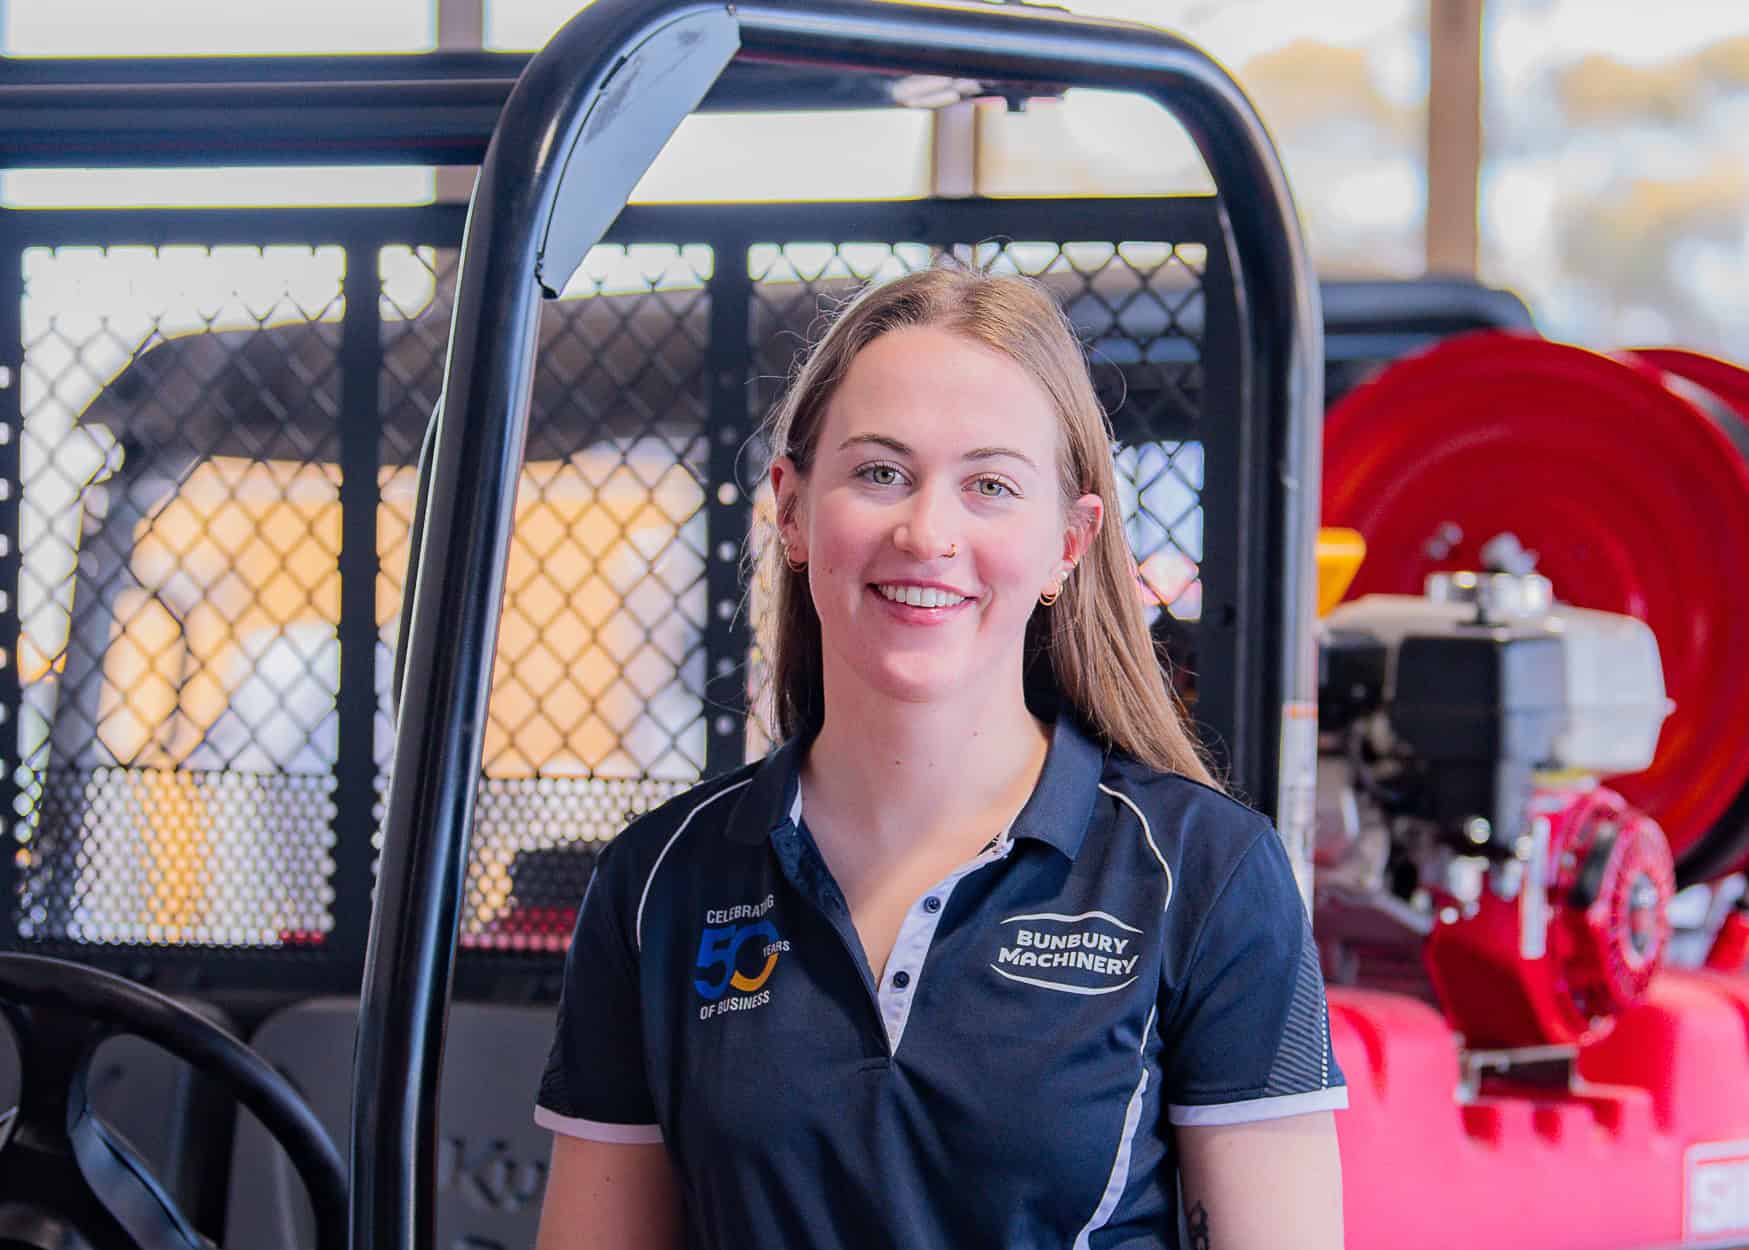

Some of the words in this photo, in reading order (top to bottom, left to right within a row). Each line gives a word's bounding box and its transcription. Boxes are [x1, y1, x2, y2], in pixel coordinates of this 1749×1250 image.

[1016, 929, 1129, 955] BUNBURY
[694, 920, 779, 999] 50
[998, 947, 1139, 975] MACHINERY
[700, 1004, 716, 1020] OF
[717, 990, 770, 1015] BUSINESS
